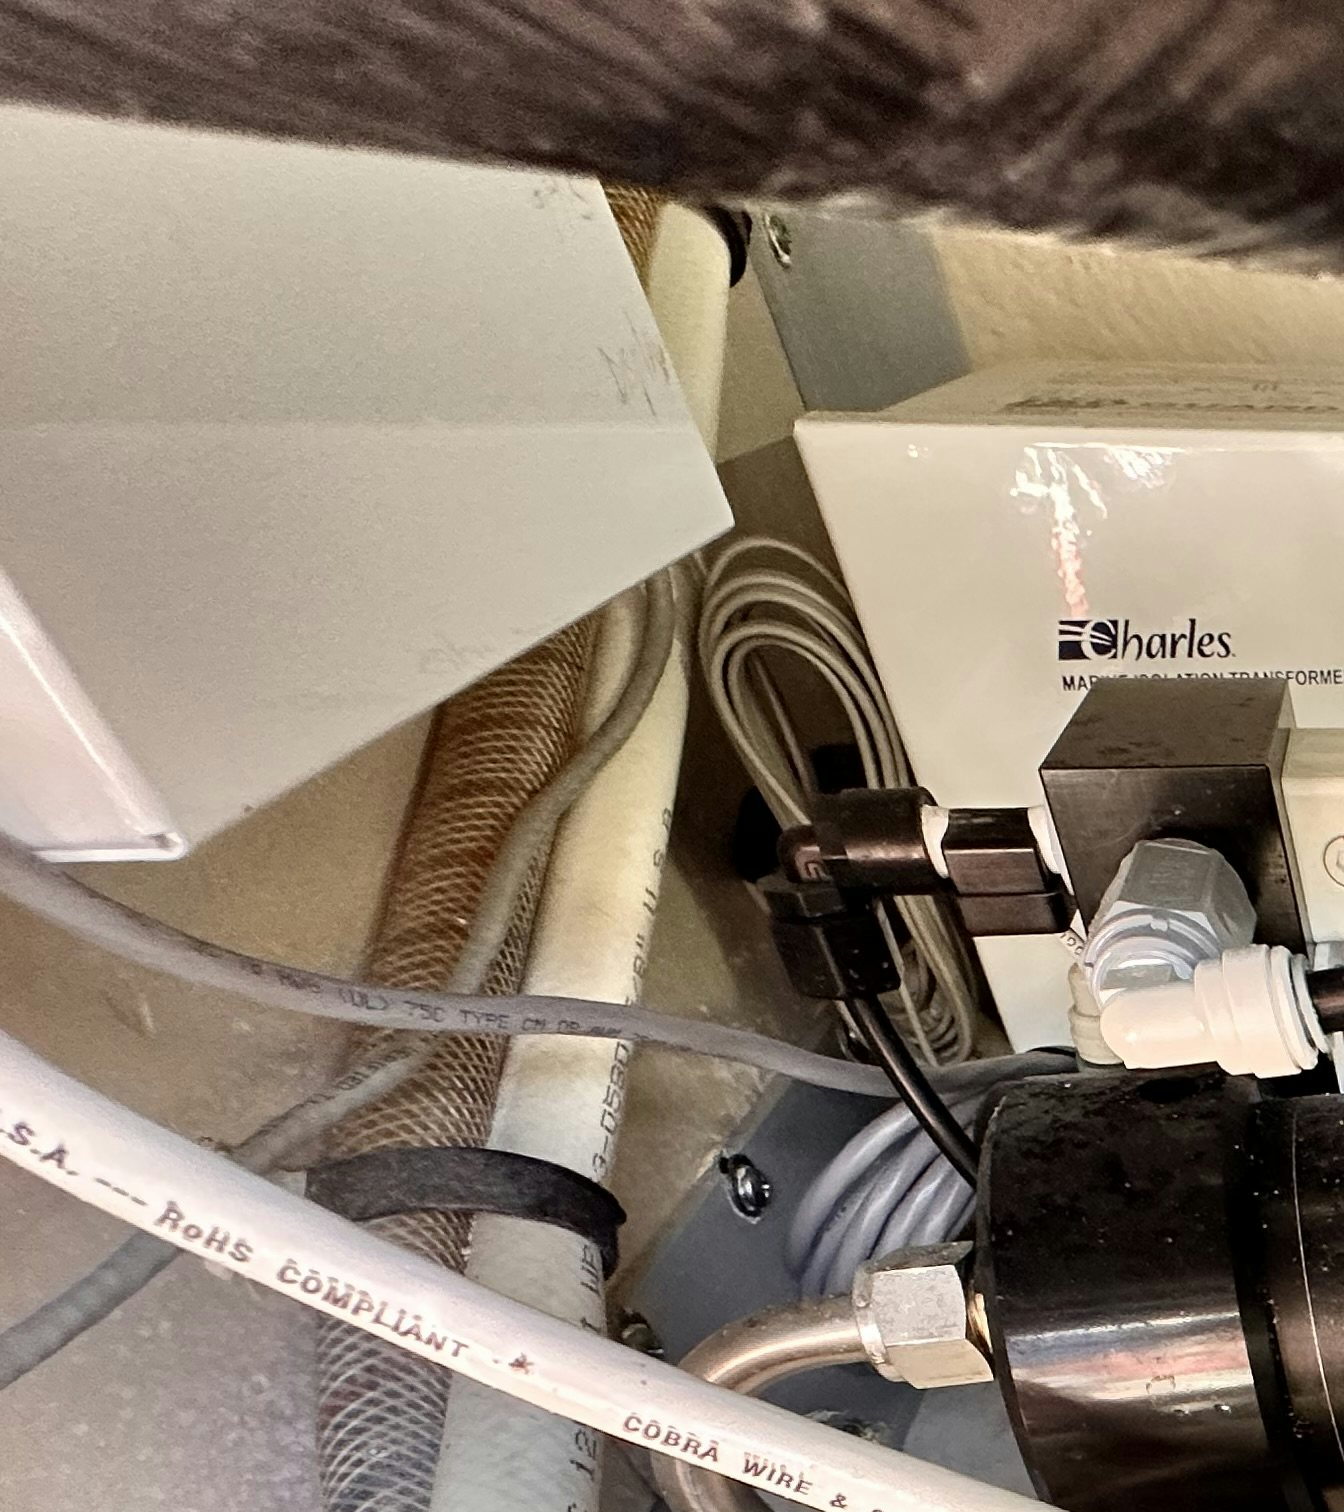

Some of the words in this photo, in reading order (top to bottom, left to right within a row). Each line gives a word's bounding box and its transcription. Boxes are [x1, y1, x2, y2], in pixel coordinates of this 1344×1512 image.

[1081, 618, 1232, 661] Charles
[1062, 674, 1128, 691] MAR
[460, 1008, 509, 1030] TYPE
[153, 1199, 254, 1263] RoHS
[276, 1258, 469, 1358] COMPLIANT
[622, 1411, 720, 1463] COBRA
[743, 1455, 814, 1496] WIRE
[829, 1493, 848, 1510] &
